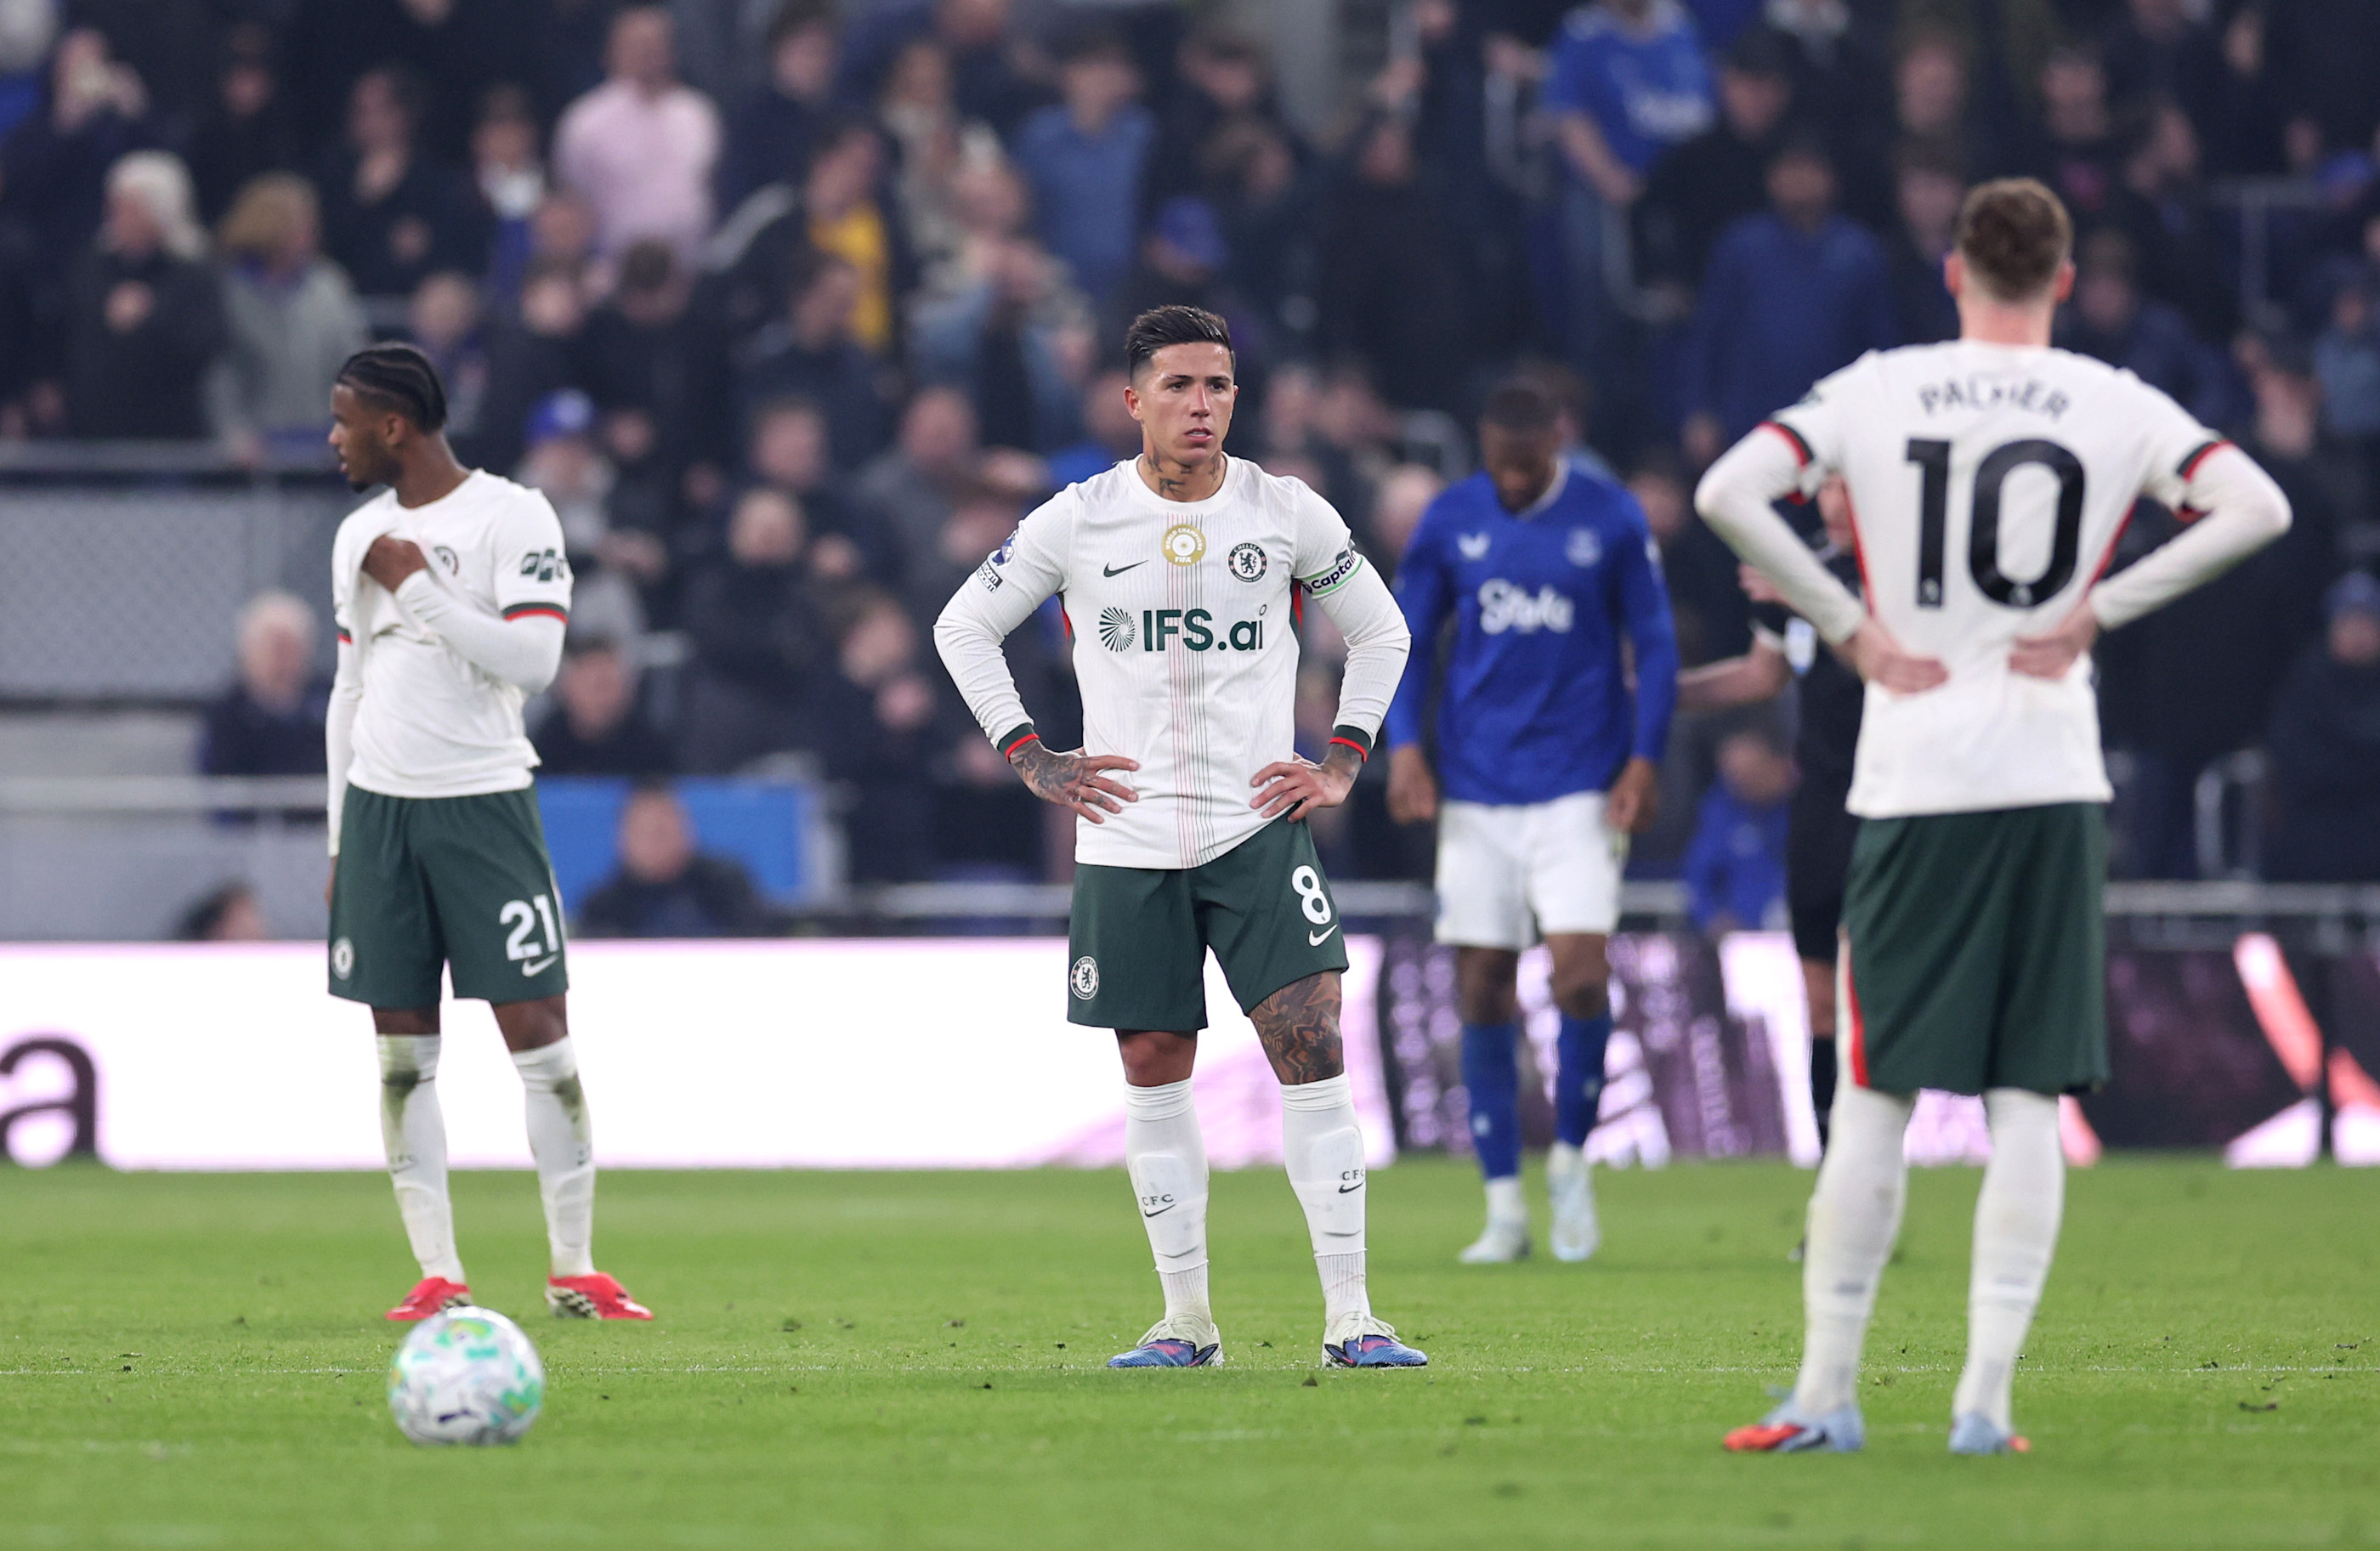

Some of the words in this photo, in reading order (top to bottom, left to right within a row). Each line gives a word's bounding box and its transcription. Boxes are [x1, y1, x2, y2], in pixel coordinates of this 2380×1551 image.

[1233, 543, 1261, 553] CHELSEA
[1906, 438, 2085, 607] 10
[1143, 604, 1267, 652] IFS.ai
[1291, 864, 1332, 925] 8
[500, 893, 558, 961] 21
[1142, 1193, 1174, 1206] CFC
